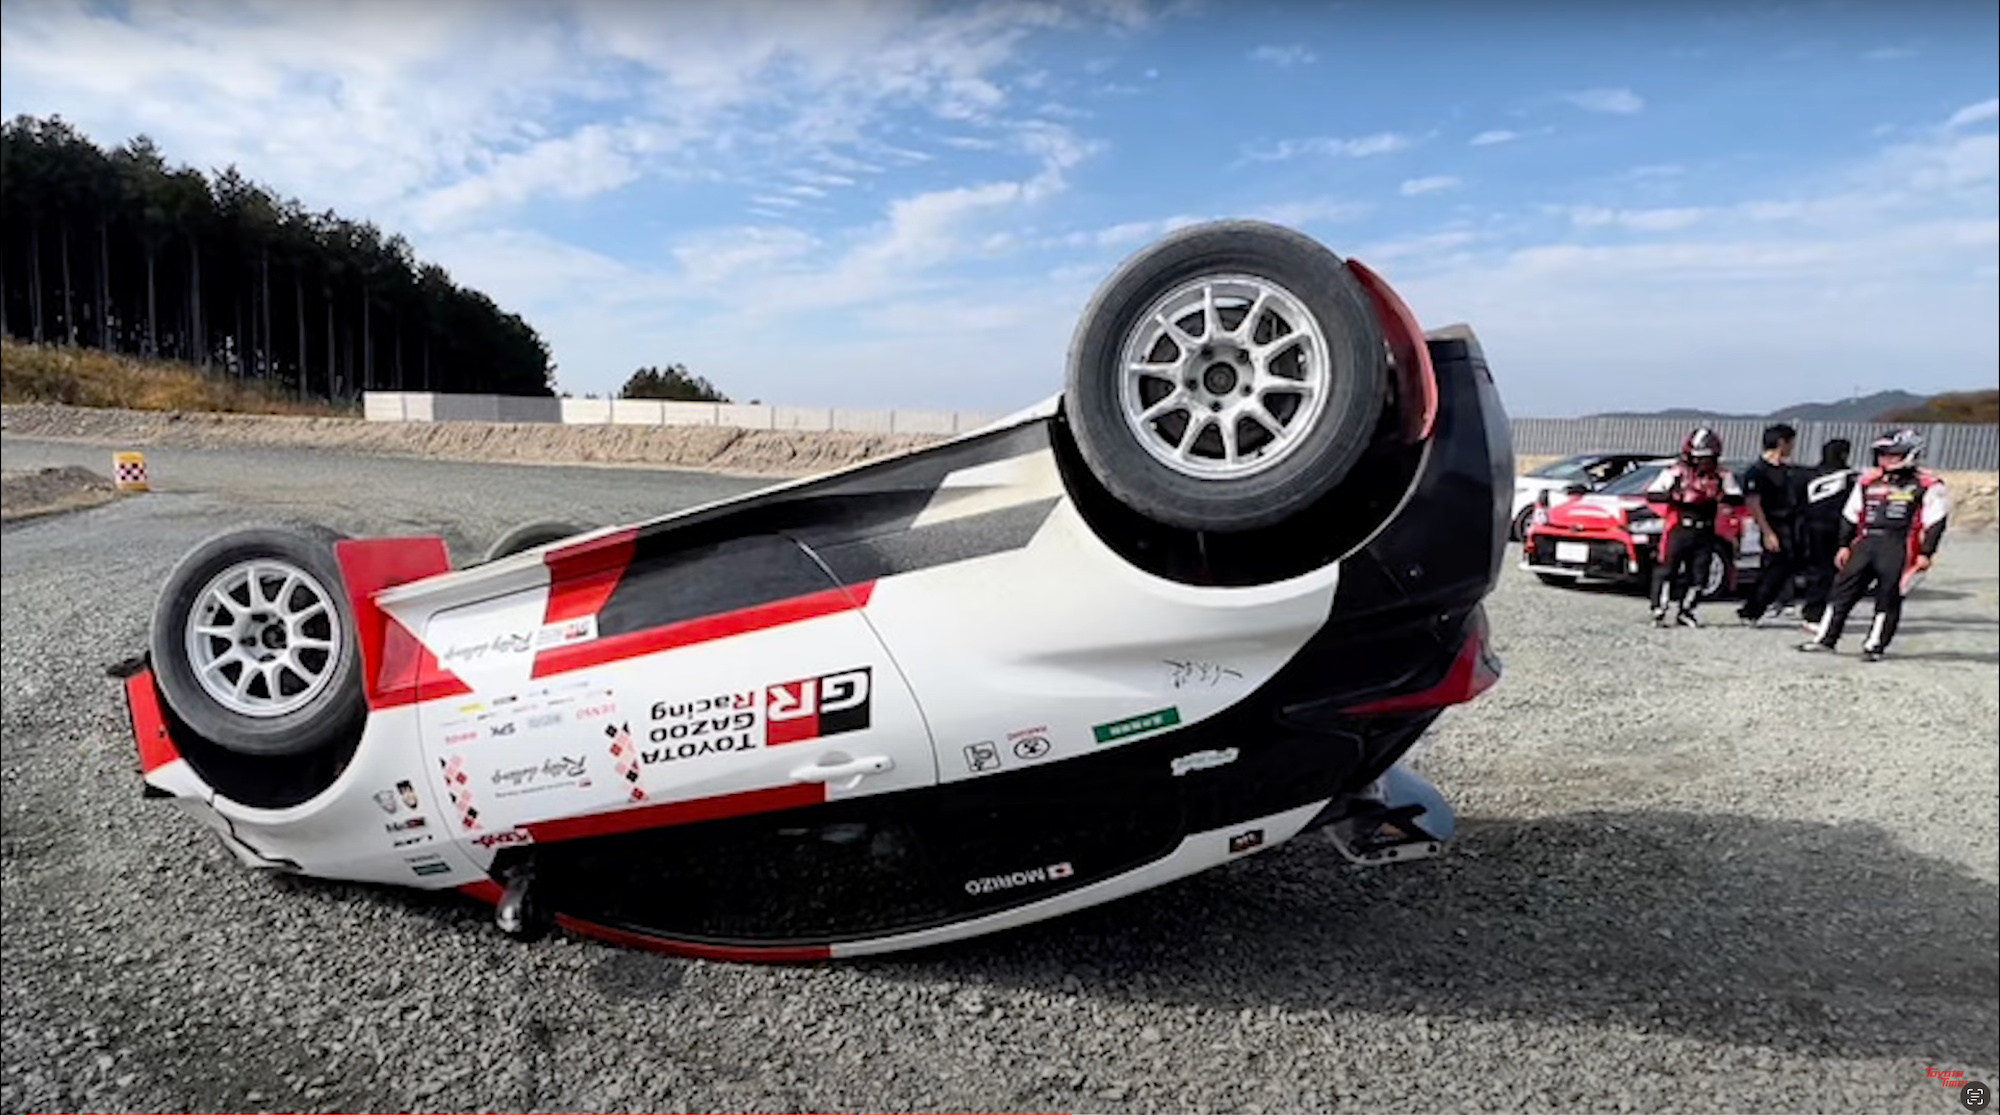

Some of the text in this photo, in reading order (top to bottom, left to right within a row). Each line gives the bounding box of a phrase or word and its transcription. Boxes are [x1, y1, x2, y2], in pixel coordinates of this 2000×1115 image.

[651, 691, 754, 720] Racing
[767, 669, 870, 726] GR
[650, 712, 755, 743] GAZOO
[641, 733, 757, 764] TOYOTA
[965, 867, 1045, 896] MORIZO
